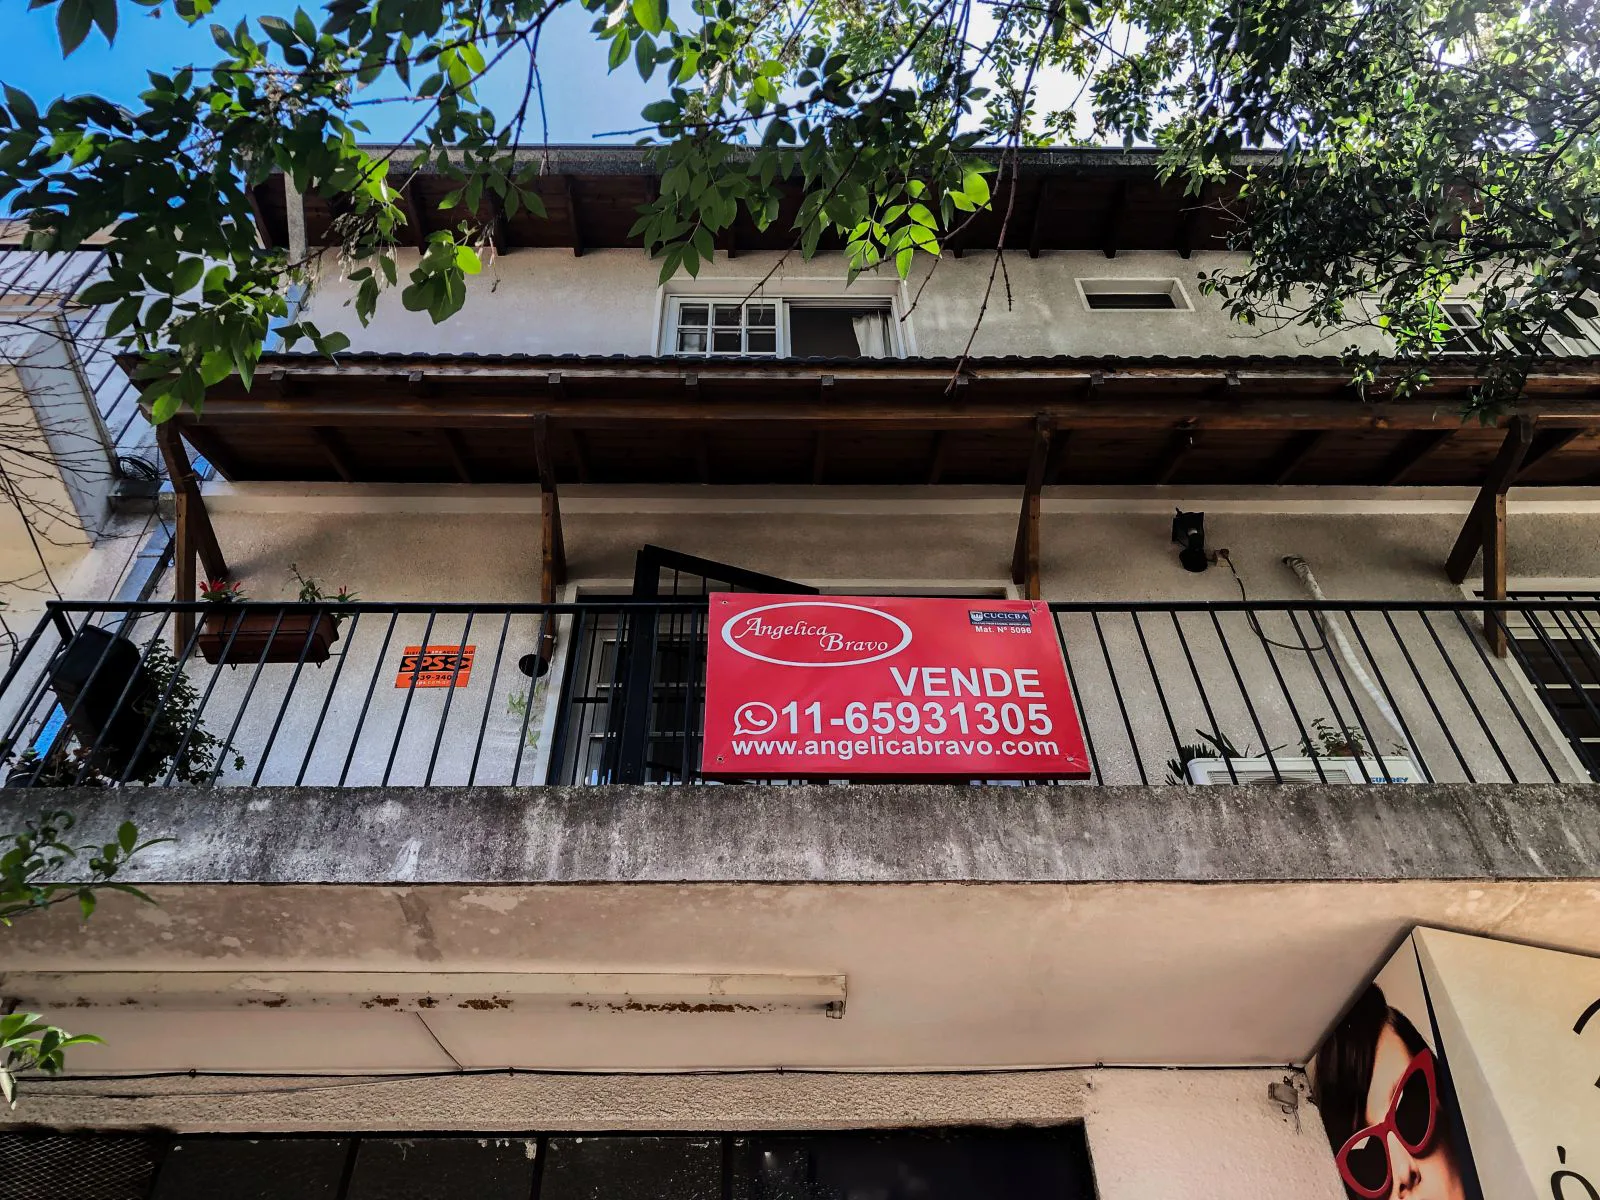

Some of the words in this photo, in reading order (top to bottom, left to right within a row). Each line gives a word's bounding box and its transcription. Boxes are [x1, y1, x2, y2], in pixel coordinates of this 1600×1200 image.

[734, 617, 828, 640] Angelica
[975, 625, 995, 633] Mat.
[819, 632, 889, 652] Bravo
[889, 666, 1045, 698] VENDE
[781, 701, 1053, 736] 11-65931305
[731, 735, 1060, 760] www.angelicabravo.com
